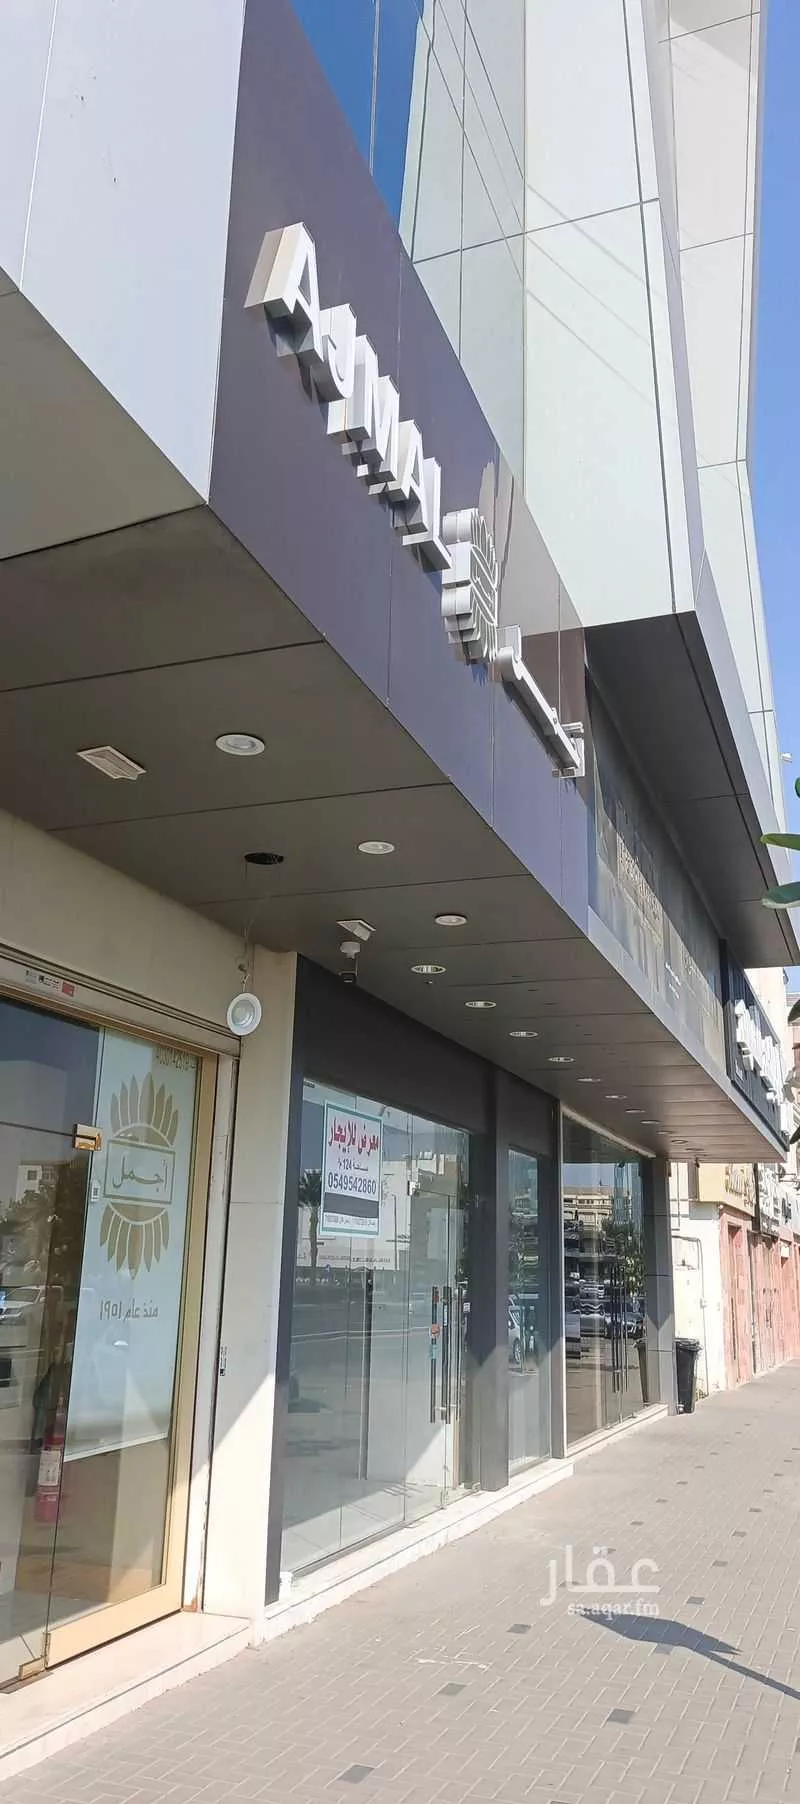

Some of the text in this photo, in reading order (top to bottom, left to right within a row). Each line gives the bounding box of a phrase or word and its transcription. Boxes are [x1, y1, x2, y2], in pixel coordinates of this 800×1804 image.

[250, 222, 452, 571] AJMAL
[358, 1122, 379, 1156] معرض
[328, 1172, 376, 1195] 0549542860
[123, 1298, 140, 1322] عام
[143, 1299, 159, 1318] منذ
